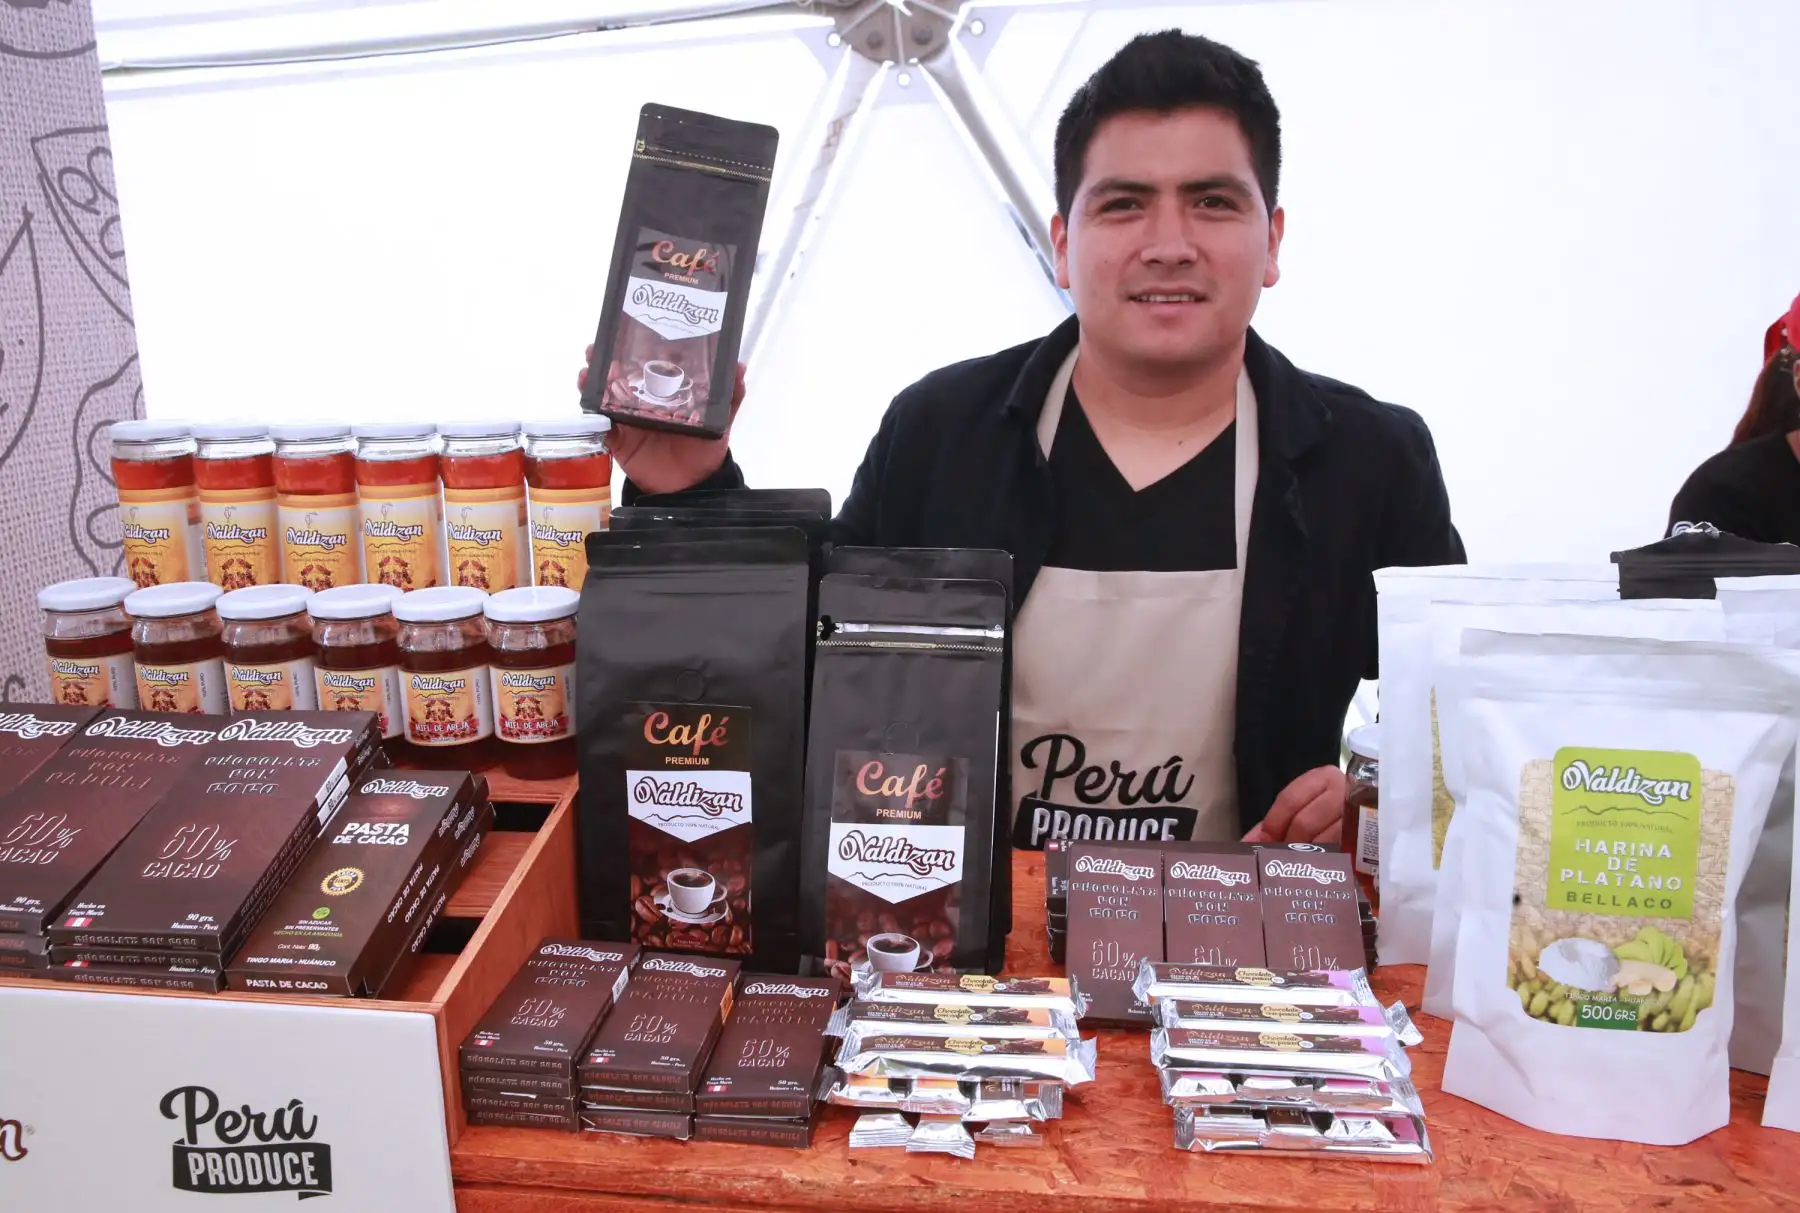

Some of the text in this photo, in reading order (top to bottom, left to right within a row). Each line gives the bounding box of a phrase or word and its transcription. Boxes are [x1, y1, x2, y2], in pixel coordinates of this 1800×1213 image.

[651, 240, 720, 276] Café
[664, 272, 699, 284] PREMIUM
[434, 724, 444, 732] DE
[523, 722, 533, 730] DE
[644, 711, 730, 755] Café
[665, 757, 710, 766] PREMIUM
[1020, 734, 1195, 805] Perú
[856, 760, 946, 809] Café
[876, 808, 922, 820] PREMIUM
[343, 822, 410, 836] PASTA
[1031, 807, 1179, 846] PRODUCE
[158, 824, 238, 860] 60%
[333, 835, 409, 846] DE CACAO
[1576, 838, 1672, 858] HARINA
[0, 847, 59, 865] ACAO
[1608, 856, 1638, 872] DE
[142, 862, 220, 879] CACAO
[1560, 868, 1682, 890] PLATANO
[1566, 891, 1673, 910] BELLACO
[186, 913, 214, 923] 90 grs.
[269, 957, 293, 965] MARIA
[1092, 968, 1135, 982] CACAO
[246, 979, 328, 990] PASTA DE CACAO
[518, 998, 568, 1020] 60%
[1582, 1005, 1638, 1021] 500 GRS.
[510, 1016, 559, 1028] CACAO
[630, 1014, 680, 1035] 60%
[624, 1032, 673, 1044] CACAO
[737, 1058, 786, 1068] CACAO
[160, 1085, 318, 1145] Perú
[187, 1152, 319, 1186] PRODUCE
